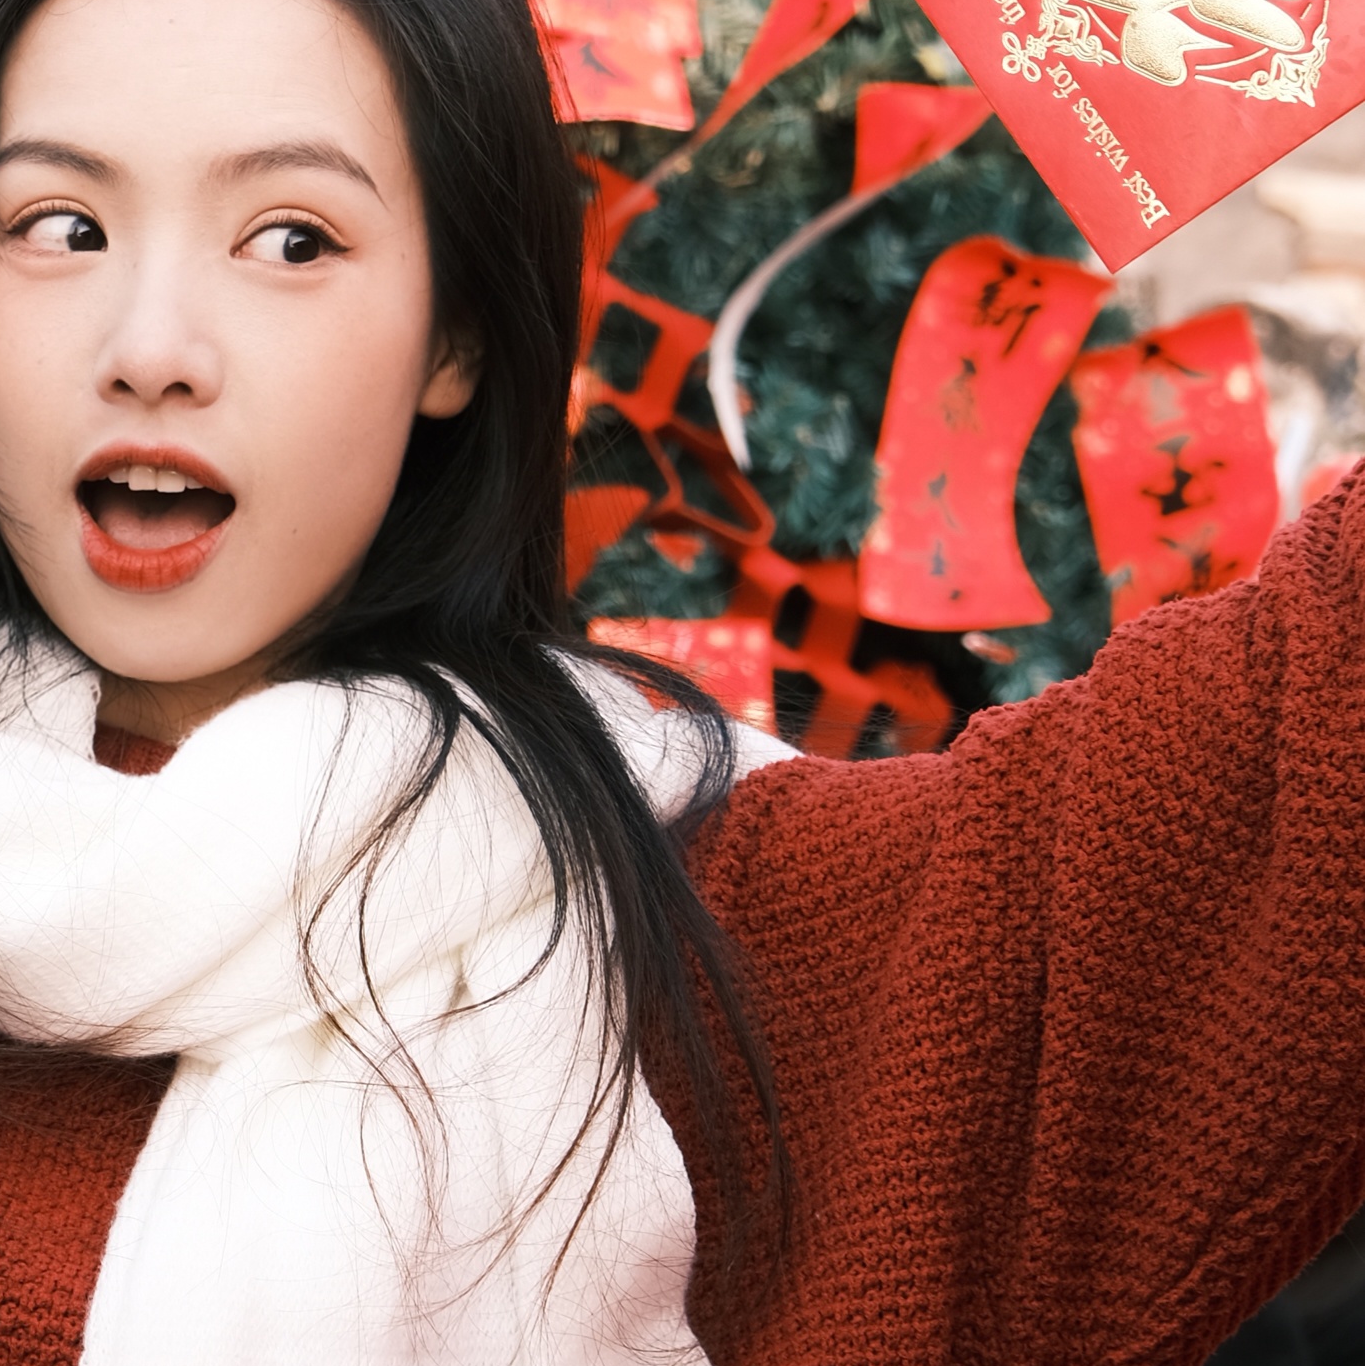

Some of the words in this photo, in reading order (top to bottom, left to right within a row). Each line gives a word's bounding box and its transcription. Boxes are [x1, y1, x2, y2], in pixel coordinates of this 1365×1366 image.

[1045, 60, 1081, 100] for
[1072, 97, 1131, 174] wishes
[1122, 171, 1171, 229] Best
